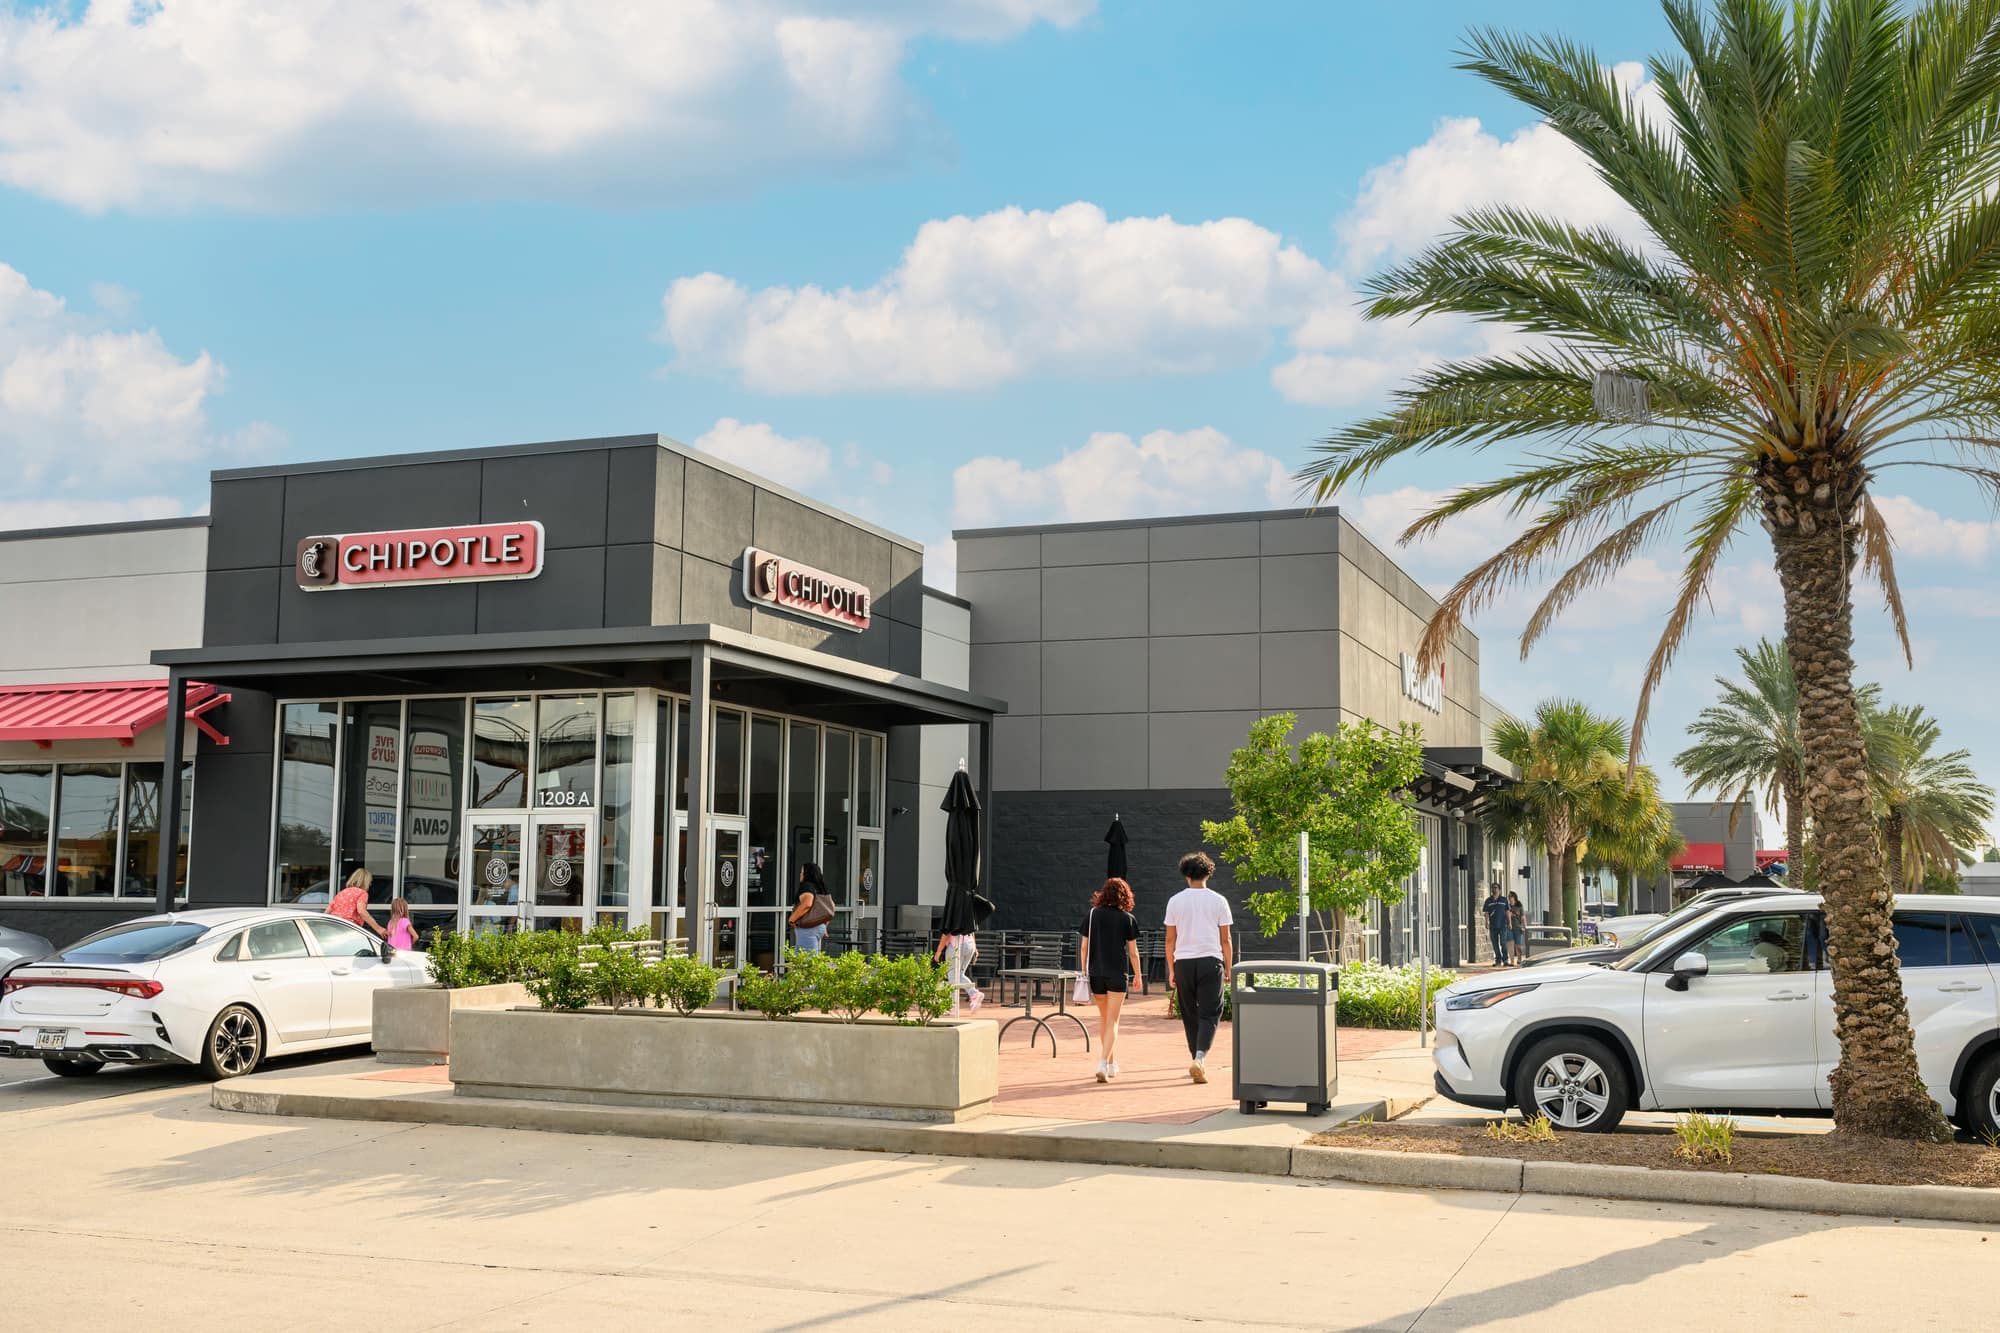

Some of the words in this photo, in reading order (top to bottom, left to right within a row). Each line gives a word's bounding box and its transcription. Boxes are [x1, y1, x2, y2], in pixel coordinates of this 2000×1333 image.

[342, 533, 524, 572] CHIPOTLE
[787, 570, 870, 618] CHIPOTLE
[539, 791, 575, 806] 1208
[578, 791, 590, 806] A
